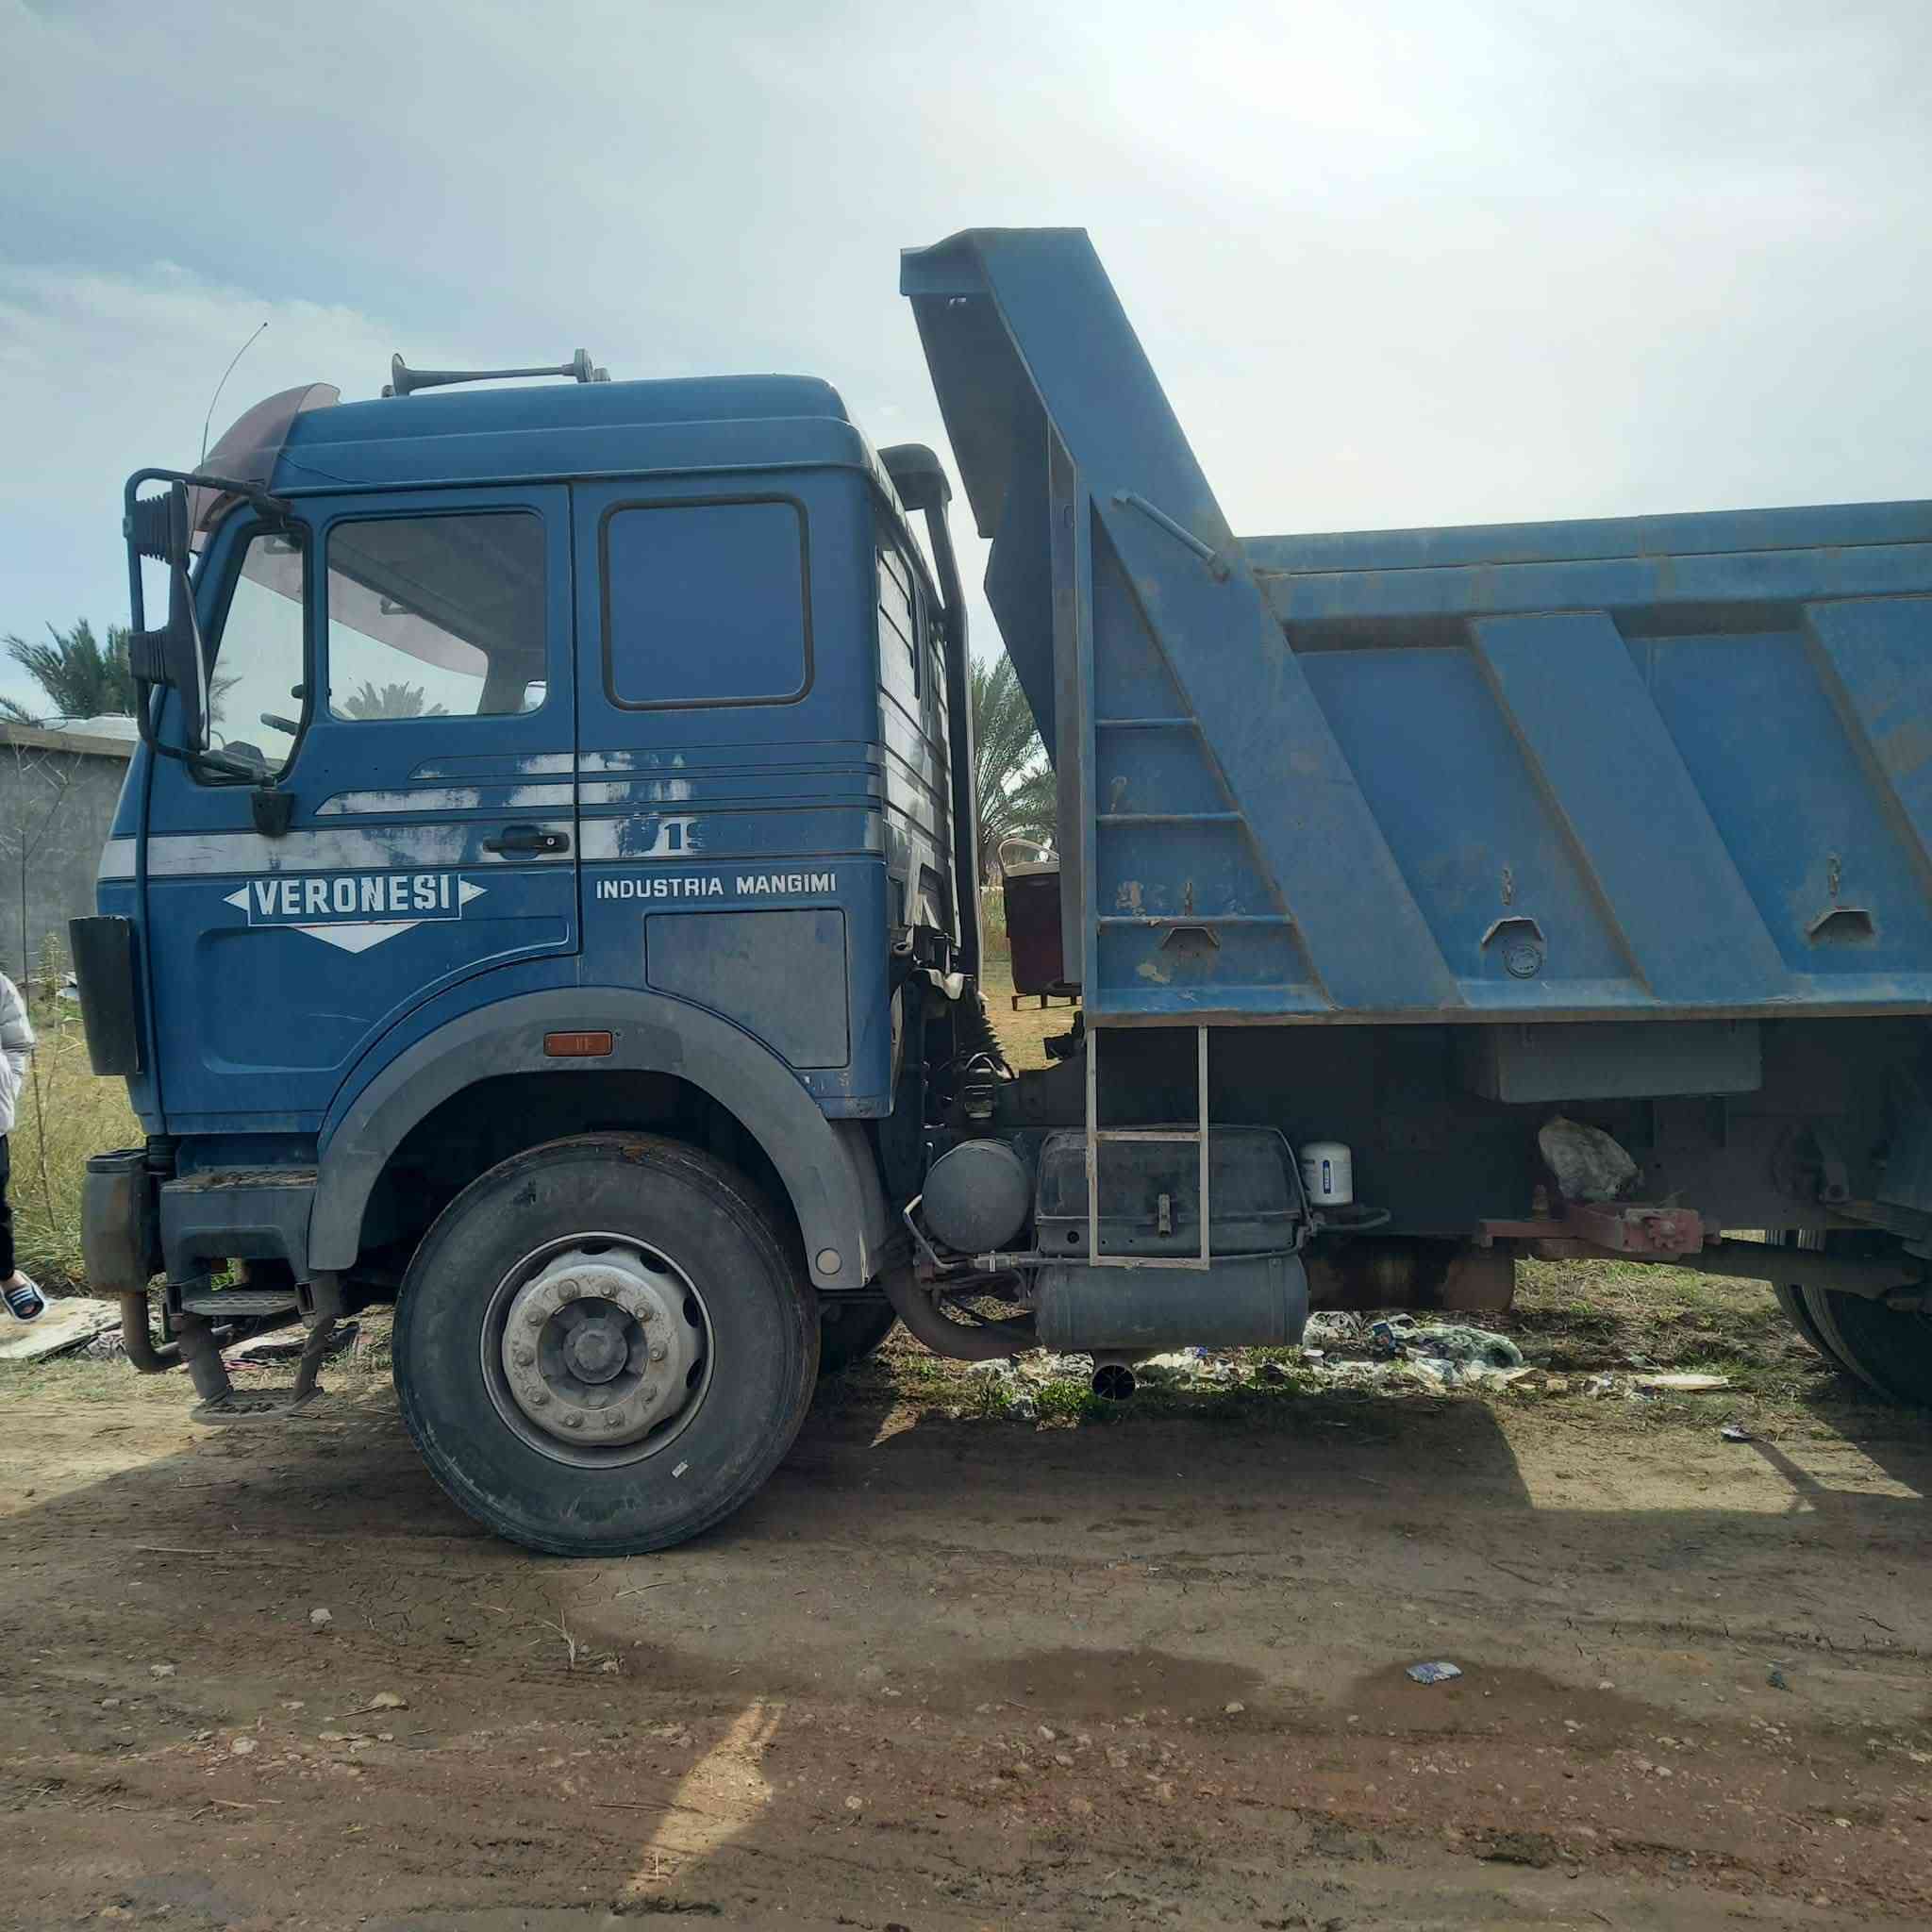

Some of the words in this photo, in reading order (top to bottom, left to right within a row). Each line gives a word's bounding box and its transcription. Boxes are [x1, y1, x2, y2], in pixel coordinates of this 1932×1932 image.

[254, 874, 451, 915] VERONESI
[595, 877, 724, 899] INDUSTRIA
[735, 874, 838, 895] MANGIMI
